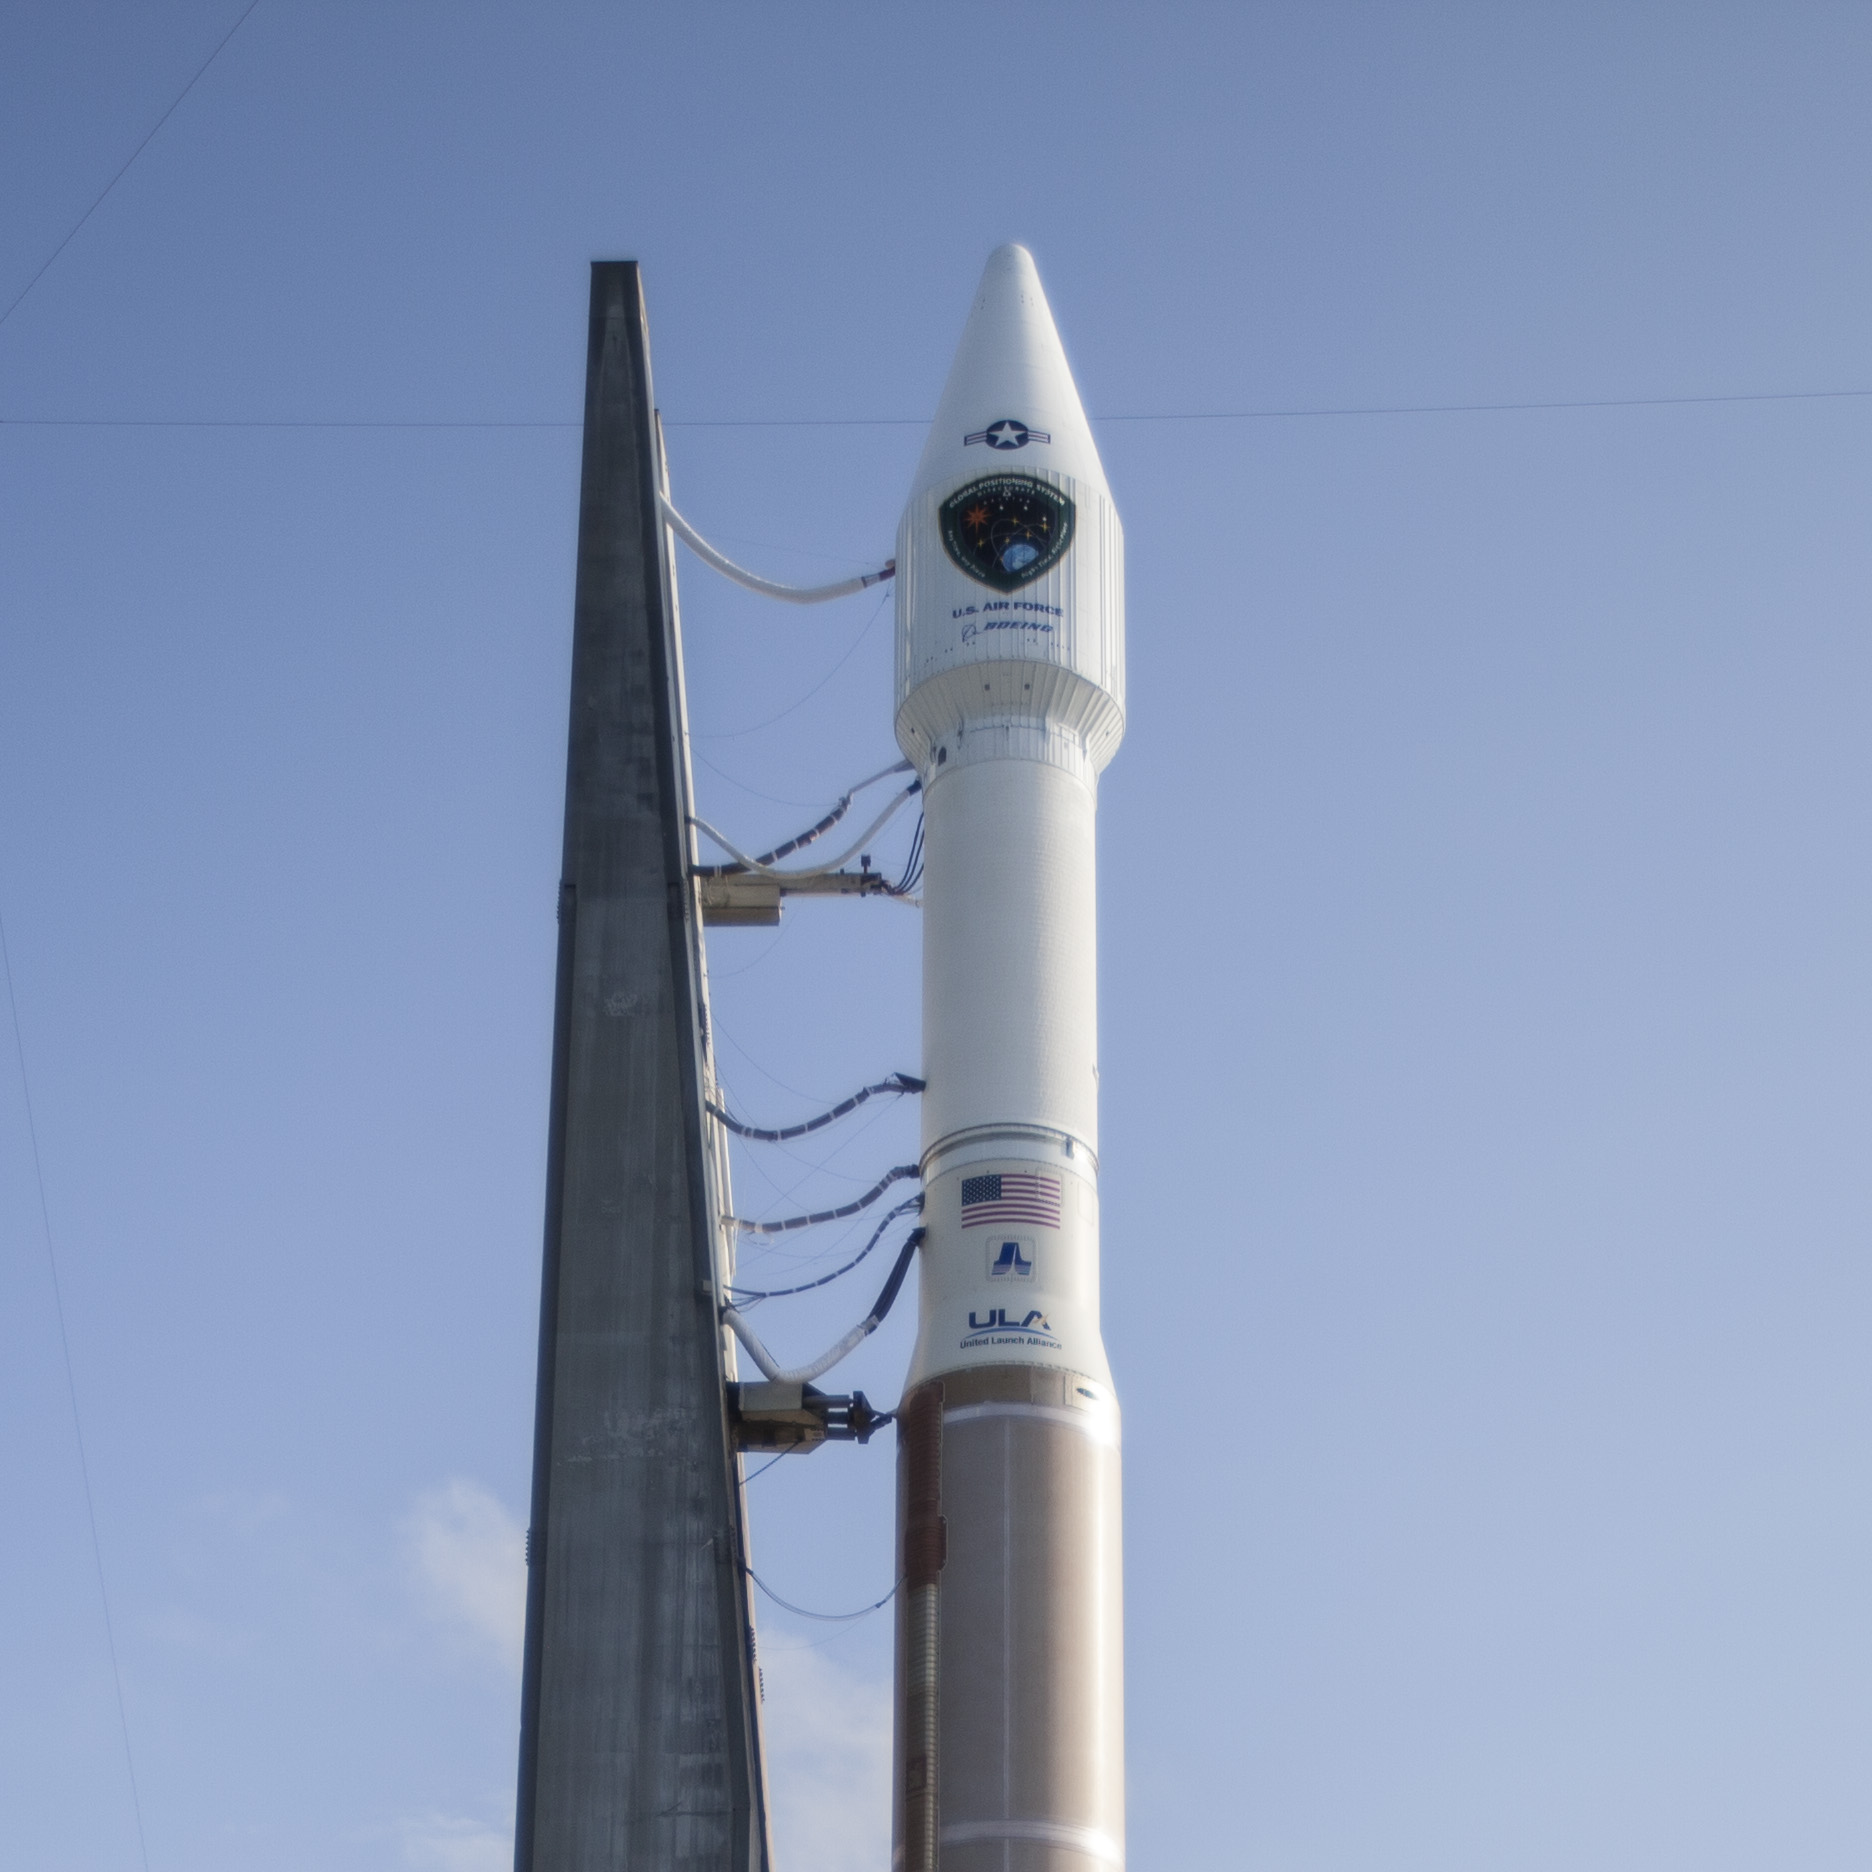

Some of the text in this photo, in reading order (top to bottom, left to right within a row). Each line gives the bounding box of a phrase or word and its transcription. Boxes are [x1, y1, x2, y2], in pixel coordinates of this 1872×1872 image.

[949, 486, 977, 507] GLOBAL
[979, 478, 1033, 489] POSITIONING
[1036, 485, 1065, 506] SYSTEM
[952, 601, 1064, 619] U.S. AIR FORCE
[983, 621, 1054, 633] BOEING
[969, 1308, 1052, 1331] ULA
[960, 1336, 1063, 1351] United Launch Alliance
